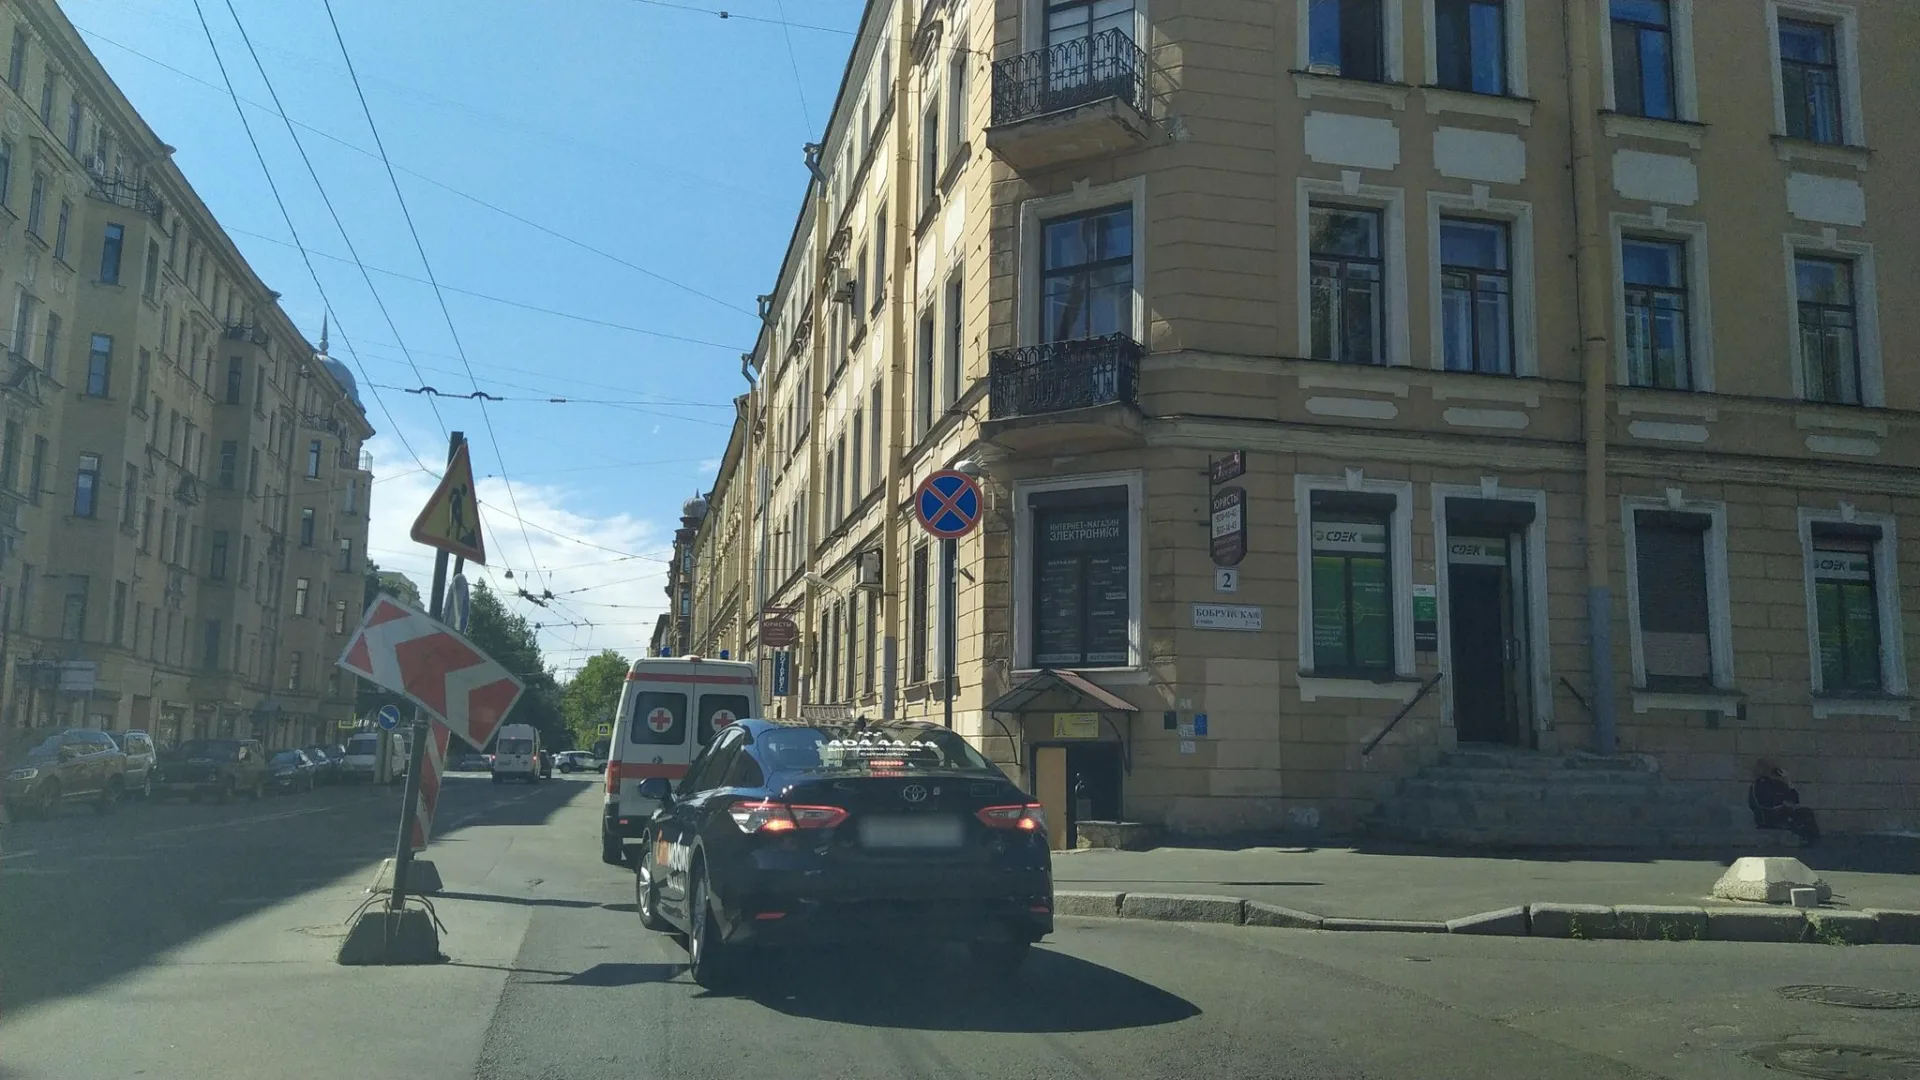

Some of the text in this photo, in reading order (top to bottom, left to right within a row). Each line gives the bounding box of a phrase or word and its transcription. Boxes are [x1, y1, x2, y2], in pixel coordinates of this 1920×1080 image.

[1213, 492, 1239, 511] ЮРИСТЫ
[1050, 519, 1119, 530] ИНТЕРНЕТ-МАГАЗИН
[1049, 527, 1119, 541] ЭЛЕКТРОНИКИ
[1326, 531, 1358, 543] CDEK
[1222, 573, 1232, 588] 2
[778, 651, 786, 692] НОТАРИУС
